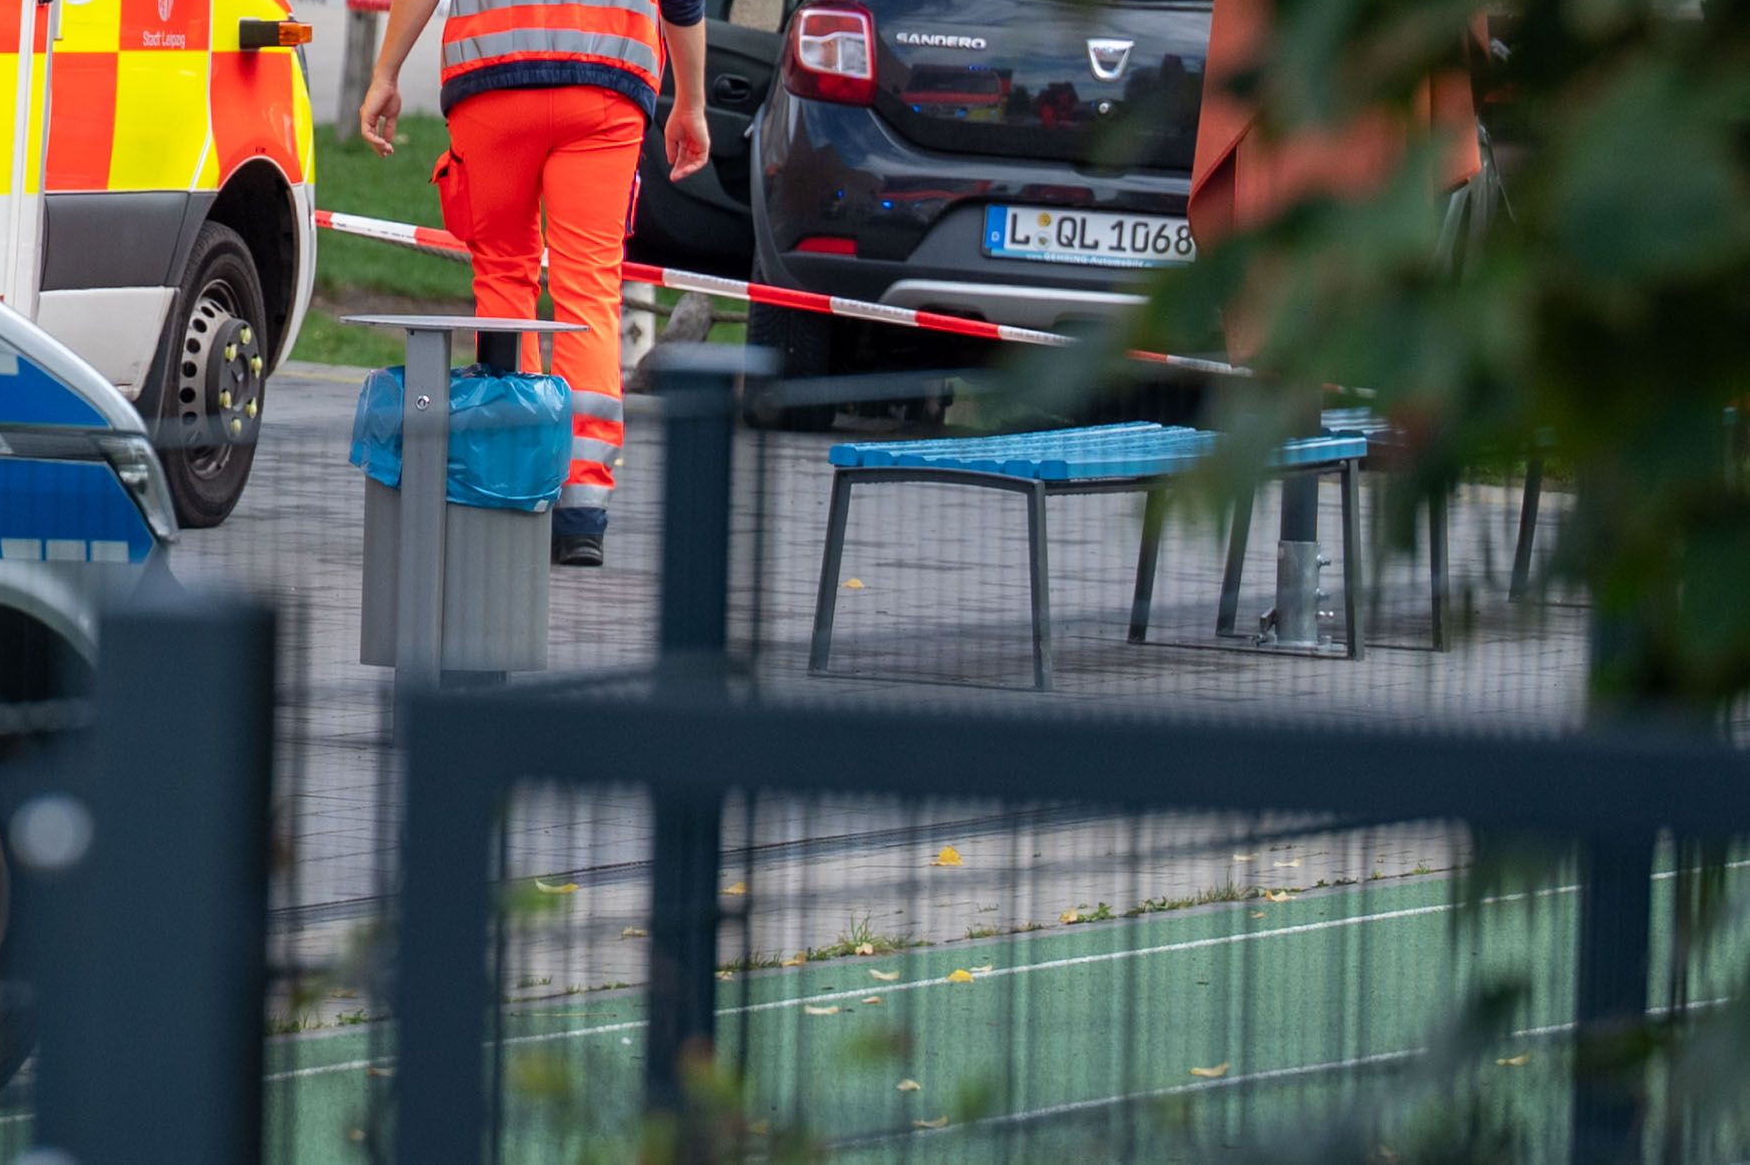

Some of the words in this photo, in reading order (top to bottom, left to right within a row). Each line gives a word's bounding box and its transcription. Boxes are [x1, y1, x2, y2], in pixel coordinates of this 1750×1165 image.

[896, 32, 987, 50] SANDERO
[1010, 213, 1031, 244] L
[1056, 215, 1099, 250] QL
[1108, 220, 1192, 256] 1068
